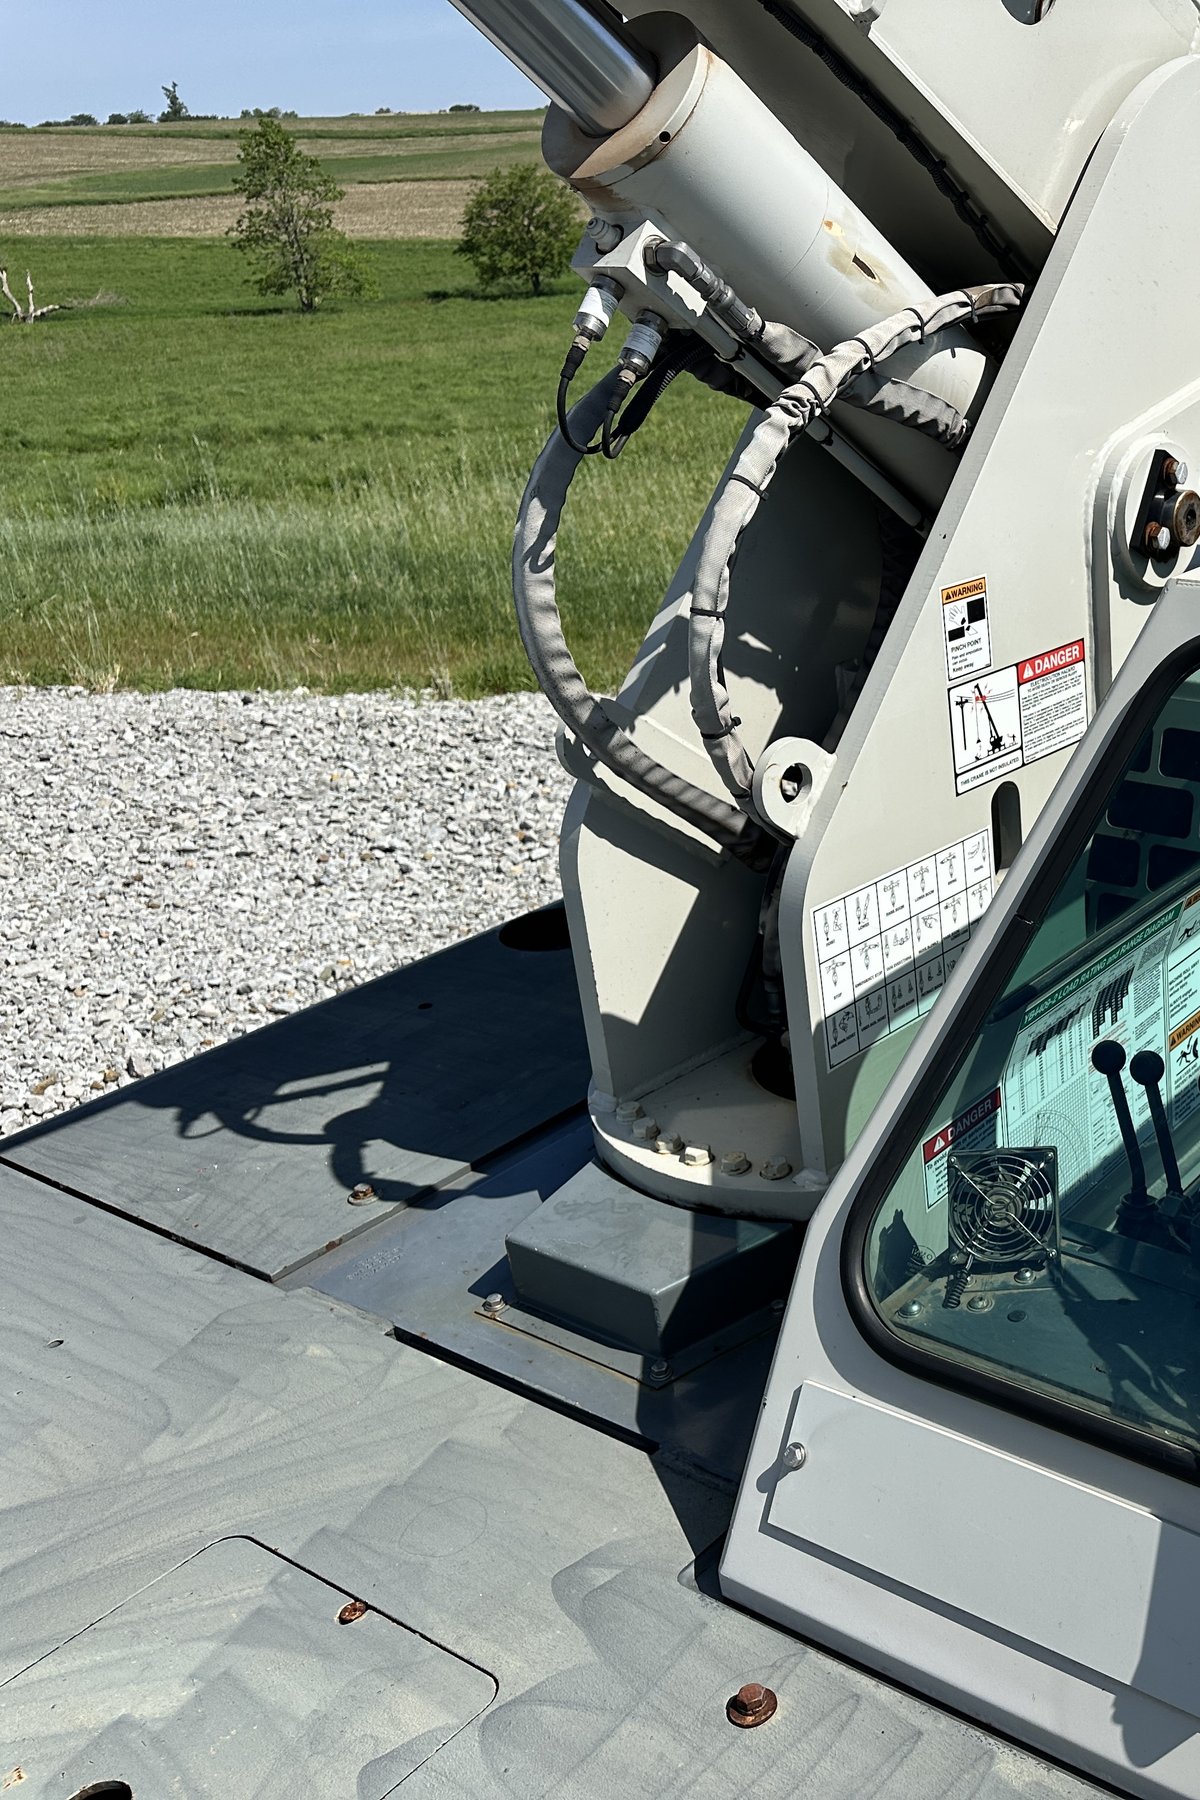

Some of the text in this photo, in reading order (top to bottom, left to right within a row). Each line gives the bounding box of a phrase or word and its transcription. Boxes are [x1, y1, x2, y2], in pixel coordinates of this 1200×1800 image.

[951, 582, 984, 599] WARNING
[951, 637, 982, 653] PINCH POINT
[1034, 644, 1080, 675] DANGER
[960, 778, 970, 786] THIS
[970, 772, 985, 782] CRANE
[989, 765, 998, 773] NOT
[998, 756, 1020, 770] INSULATED
[1058, 978, 1080, 1001] LOAD
[1079, 959, 1107, 987] RATING
[1119, 932, 1143, 956] RANGE
[1143, 911, 1175, 938] DIAGRAM
[947, 1099, 992, 1142] DANGER
